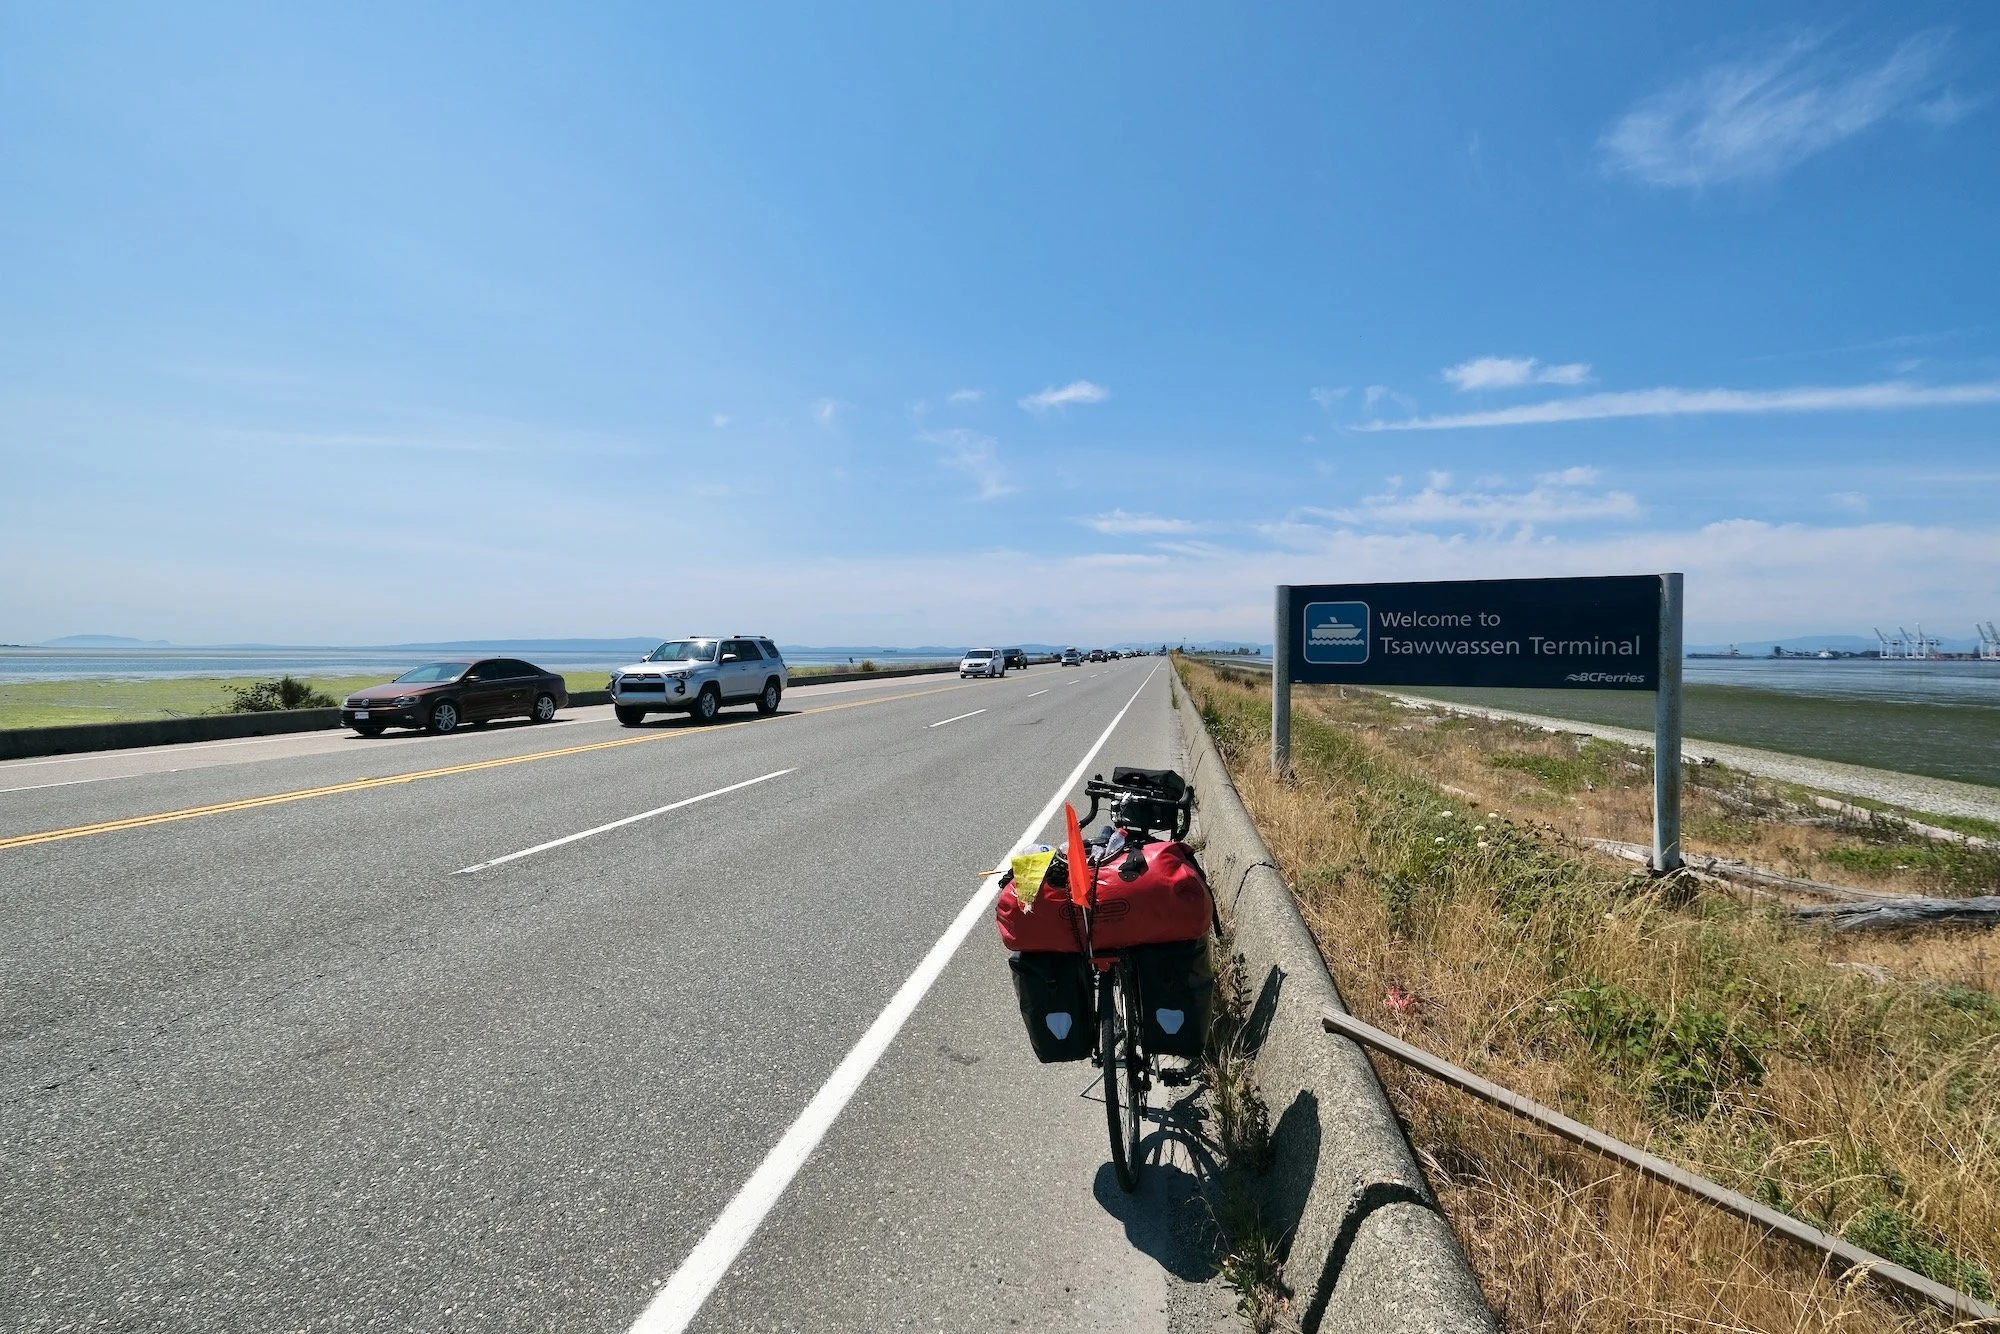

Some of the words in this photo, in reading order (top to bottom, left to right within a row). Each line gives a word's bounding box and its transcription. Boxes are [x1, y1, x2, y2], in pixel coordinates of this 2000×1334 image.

[1380, 611, 1472, 627] Welcome
[1478, 612, 1501, 627] to
[1380, 637, 1520, 655] Tsawwassen
[1529, 635, 1640, 655] Terminal
[1579, 672, 1645, 683] BCFerries
